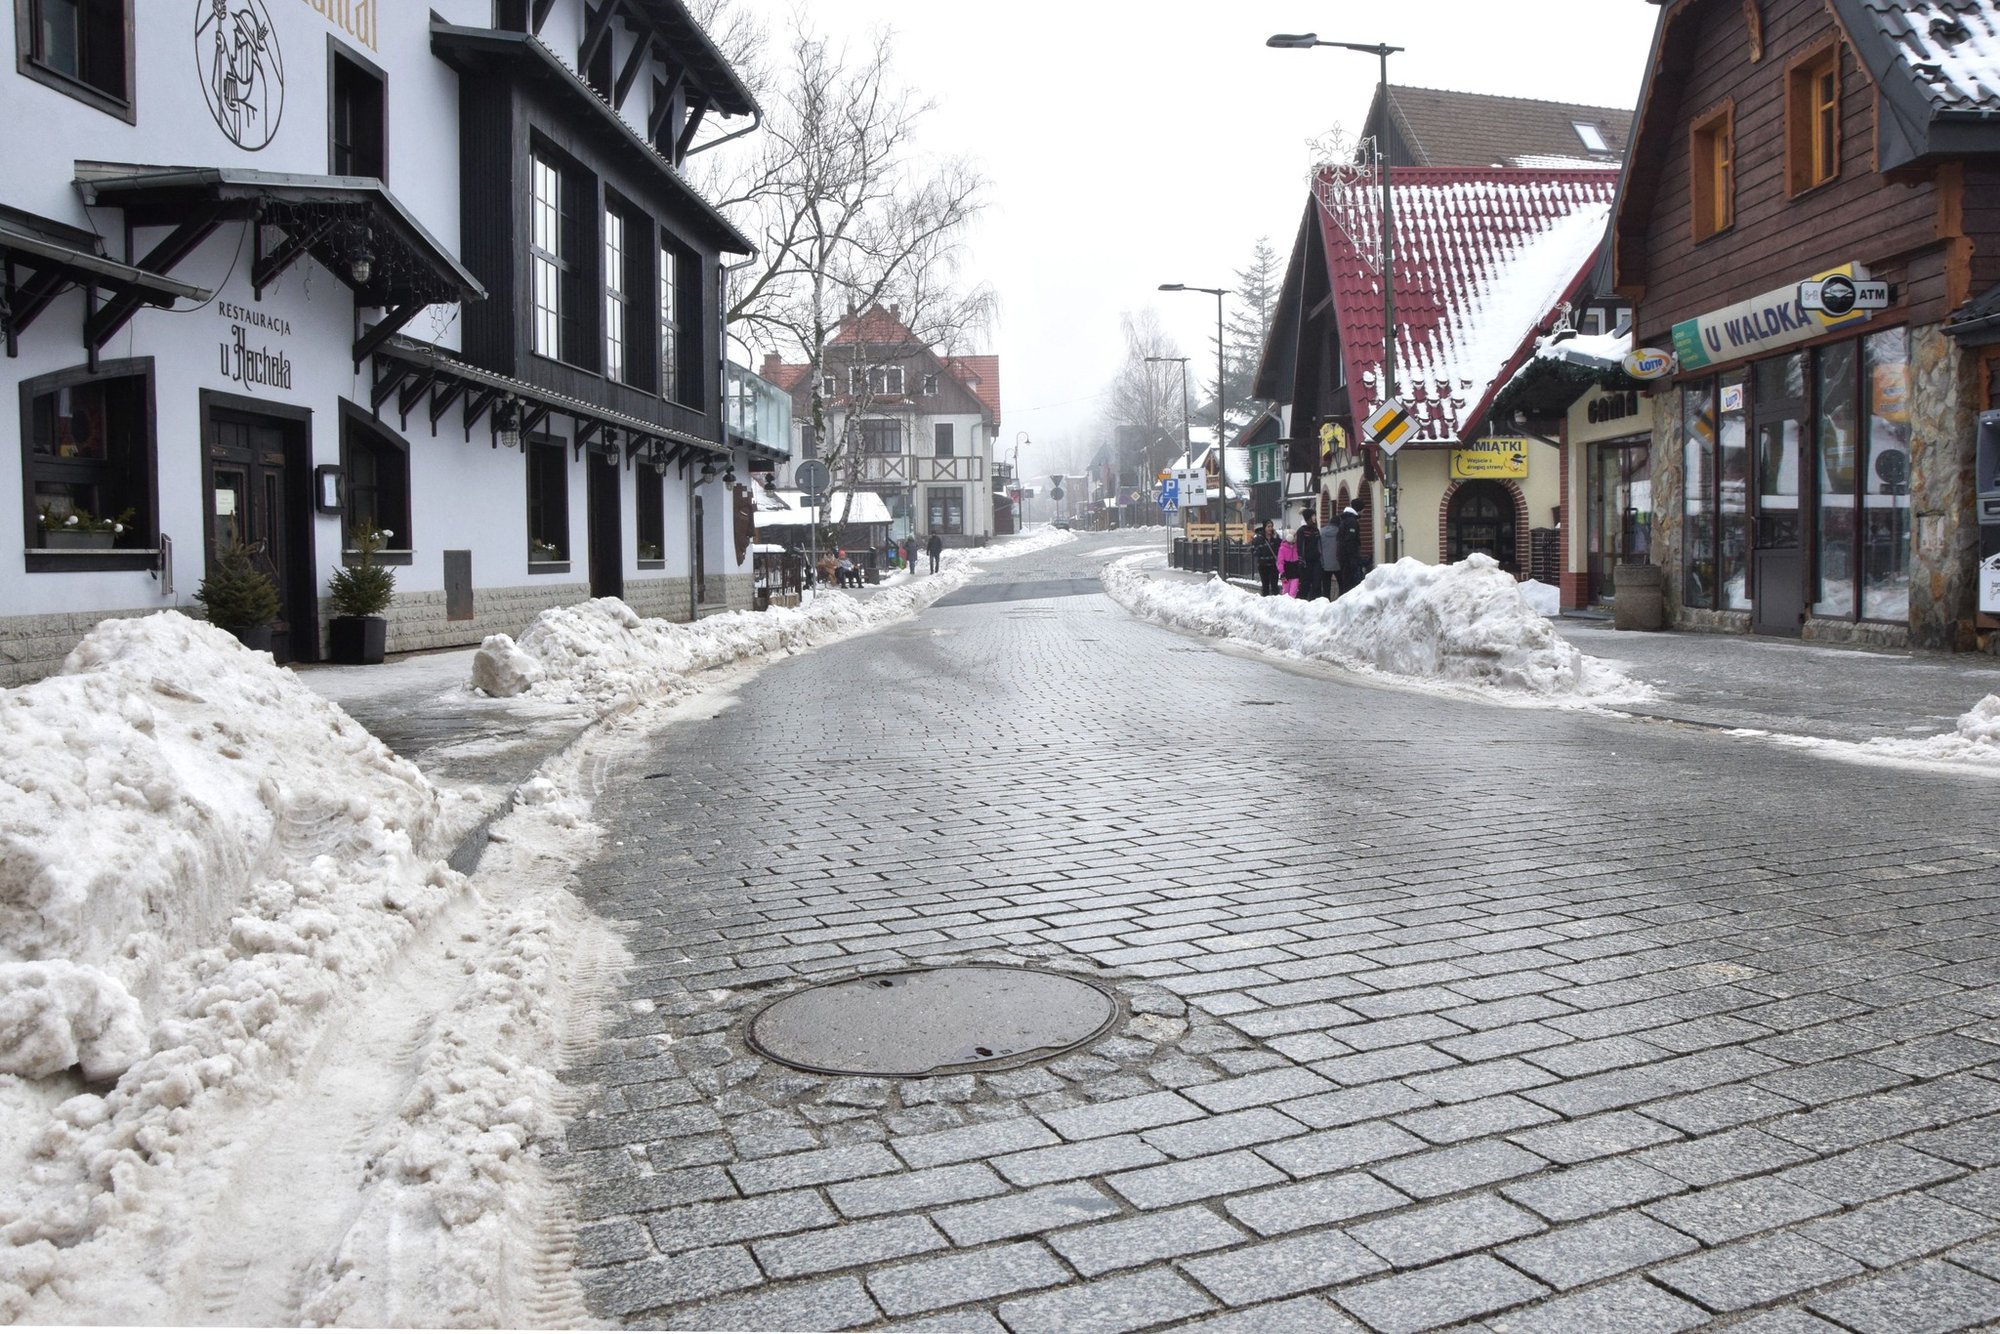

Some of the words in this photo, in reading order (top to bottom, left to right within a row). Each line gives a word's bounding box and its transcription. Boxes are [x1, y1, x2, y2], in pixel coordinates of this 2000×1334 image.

[1859, 289, 1885, 300] ATM
[219, 301, 291, 336] RESTAURACJA
[1705, 326, 1721, 352] U
[1724, 299, 1811, 347] WALDKA
[219, 342, 230, 376] u
[1467, 441, 1522, 455] MIĄTKI
[1166, 480, 1176, 492] P
